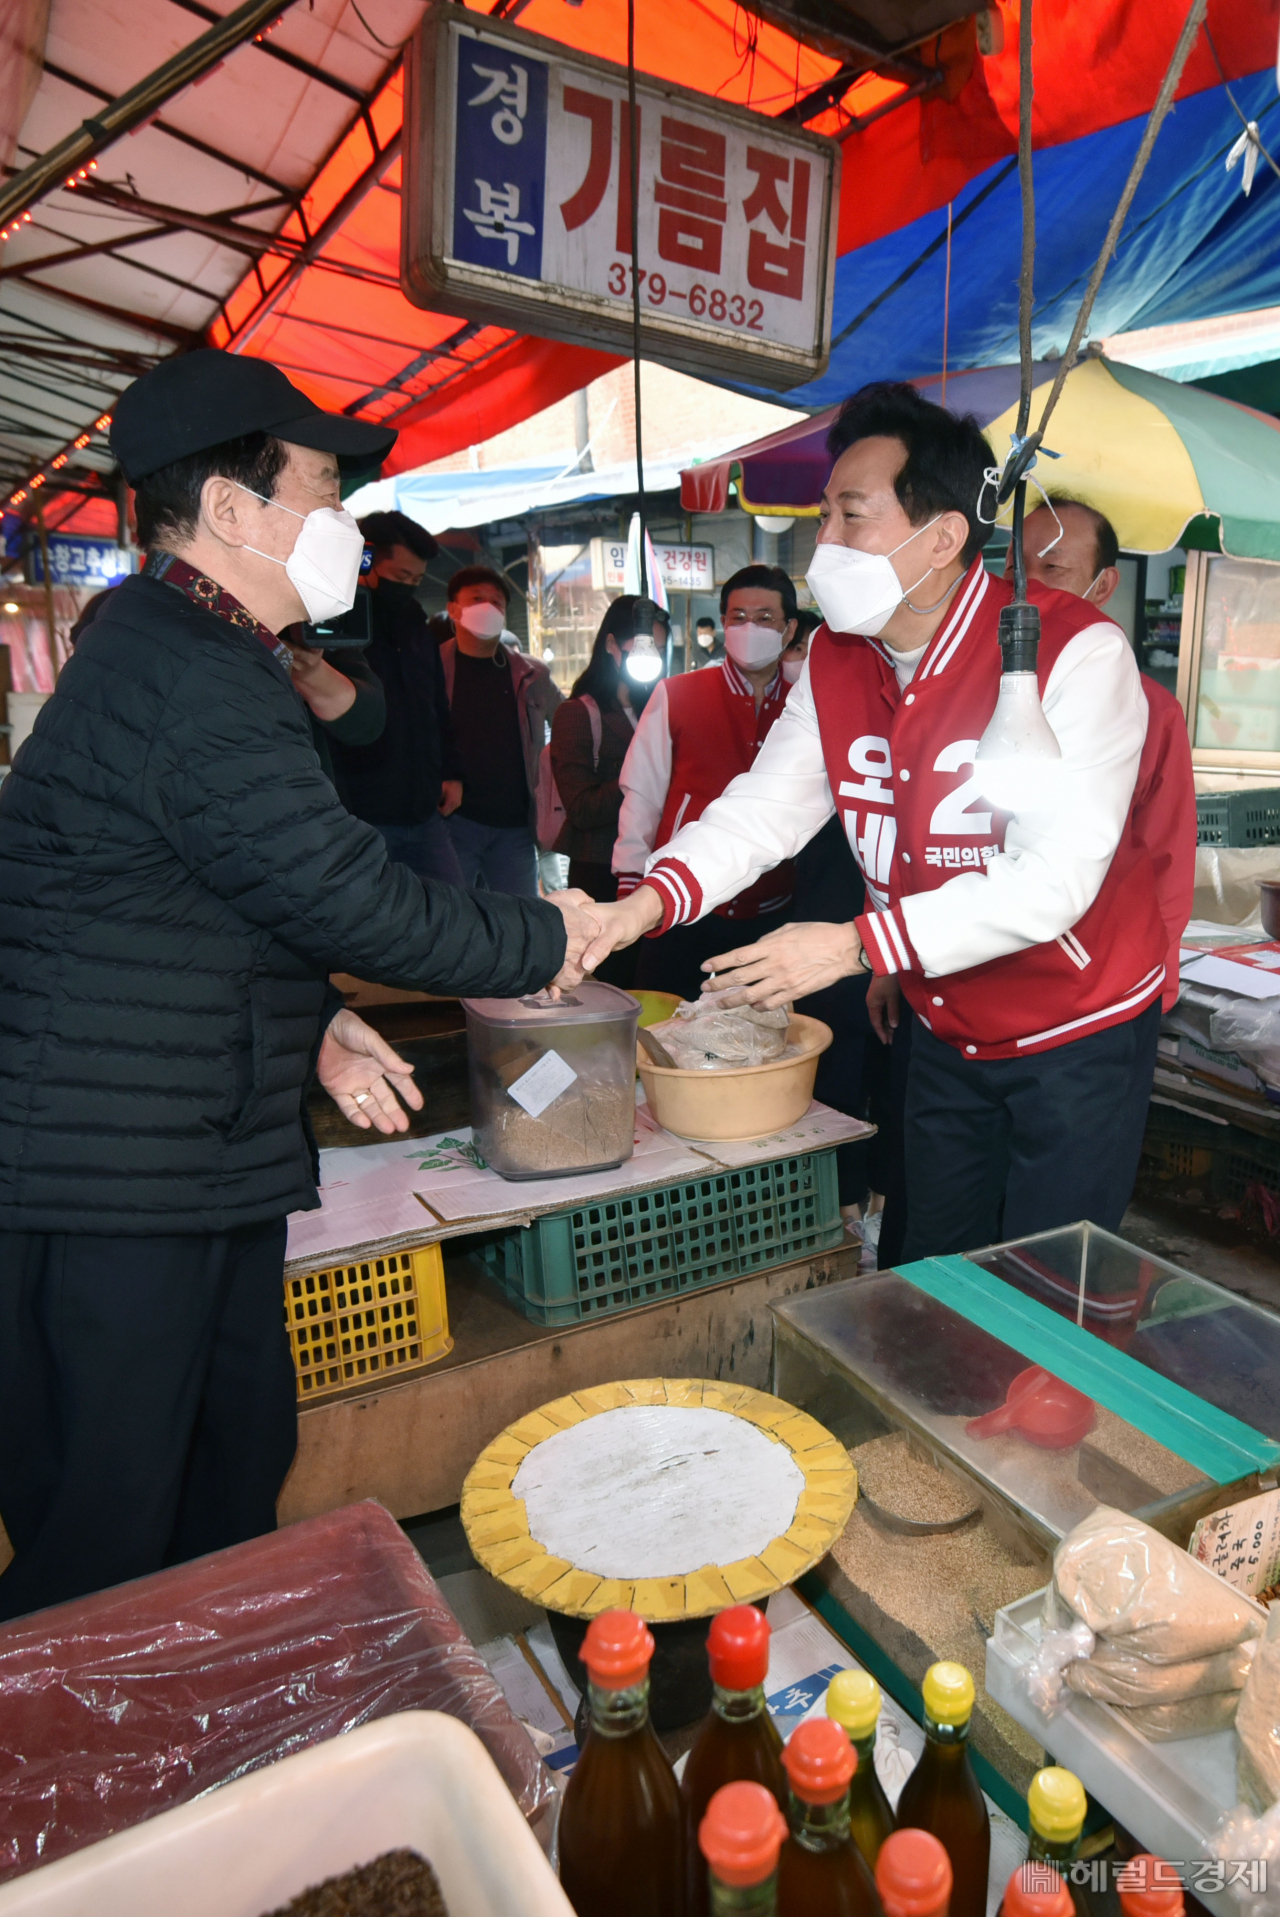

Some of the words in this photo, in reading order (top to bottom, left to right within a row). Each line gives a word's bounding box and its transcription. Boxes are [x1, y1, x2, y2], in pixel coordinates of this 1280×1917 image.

[463, 63, 536, 266] 경북
[559, 85, 811, 301] 기름집
[607, 262, 764, 332] 379-6832
[663, 551, 708, 572] 건강원
[929, 739, 993, 835] 2
